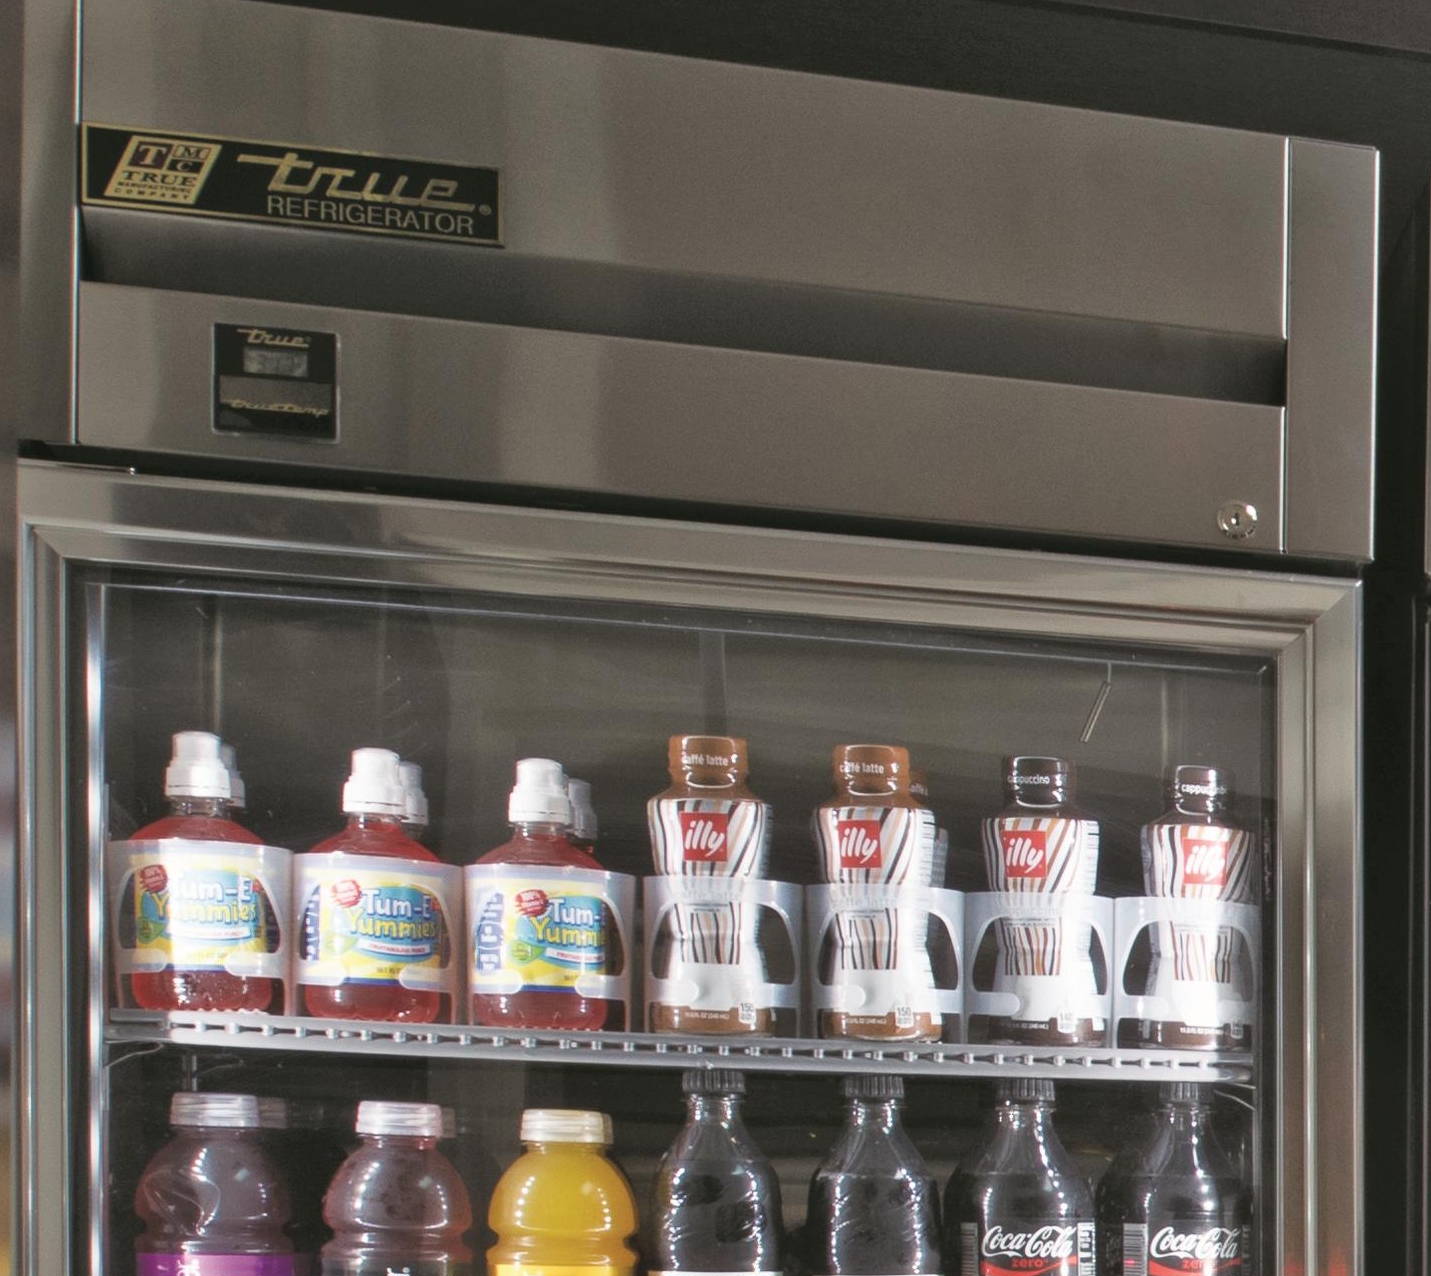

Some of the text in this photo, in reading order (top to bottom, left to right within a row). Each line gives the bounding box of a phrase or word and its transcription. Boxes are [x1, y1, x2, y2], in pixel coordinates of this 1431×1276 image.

[123, 171, 198, 187] TRUE
[238, 151, 475, 213] true
[267, 195, 474, 235] REFRIGERATOR
[862, 763, 885, 775] latte
[684, 819, 726, 858] illy
[839, 826, 880, 867] illy
[1005, 836, 1044, 875] illy
[1184, 844, 1226, 883] illy
[982, 1224, 1077, 1259] Coca-Cola
[1150, 1226, 1243, 1260] Coca-Cola
